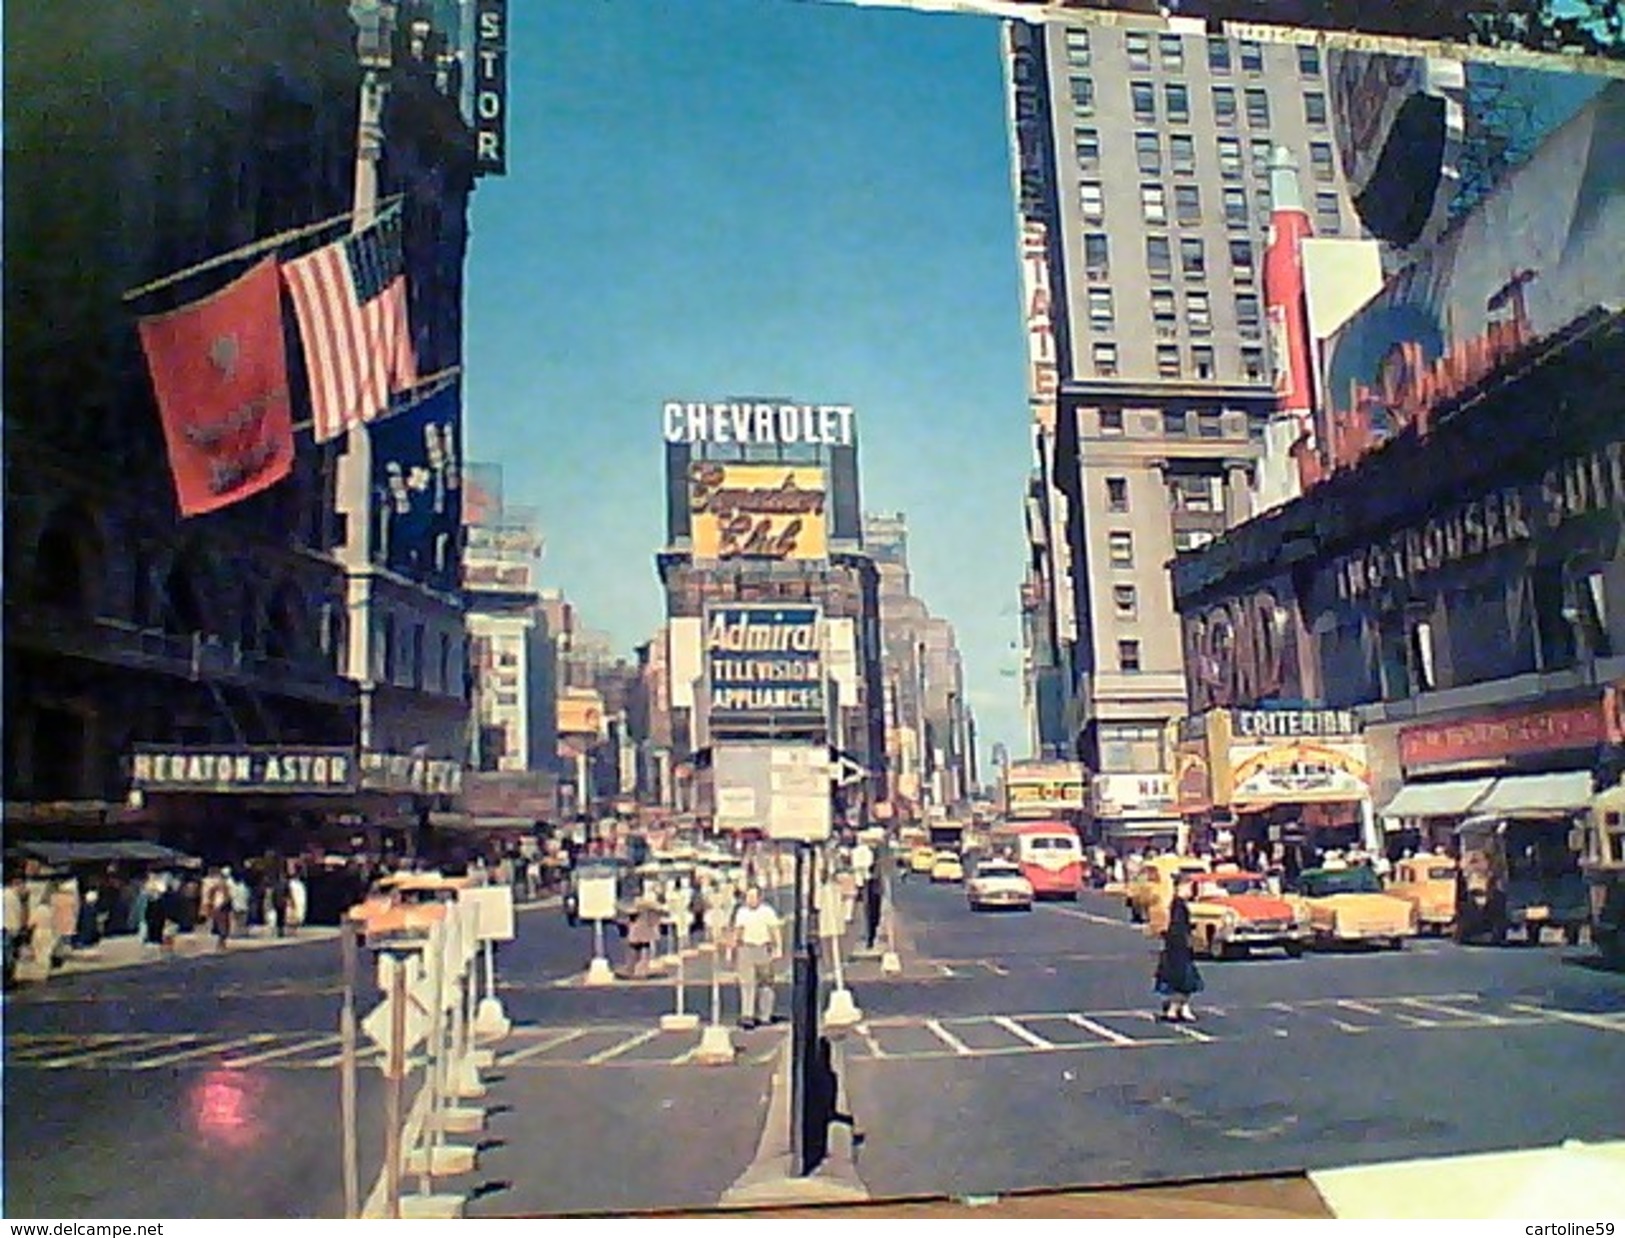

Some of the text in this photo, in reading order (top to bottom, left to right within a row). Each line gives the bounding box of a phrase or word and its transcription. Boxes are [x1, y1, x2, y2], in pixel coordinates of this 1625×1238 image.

[1024, 221, 1056, 395] STATE
[663, 402, 855, 446] CHEVROLET
[704, 611, 821, 652] Admiral
[713, 659, 821, 681] TELEVISION
[1240, 710, 1353, 735] CRITERION
